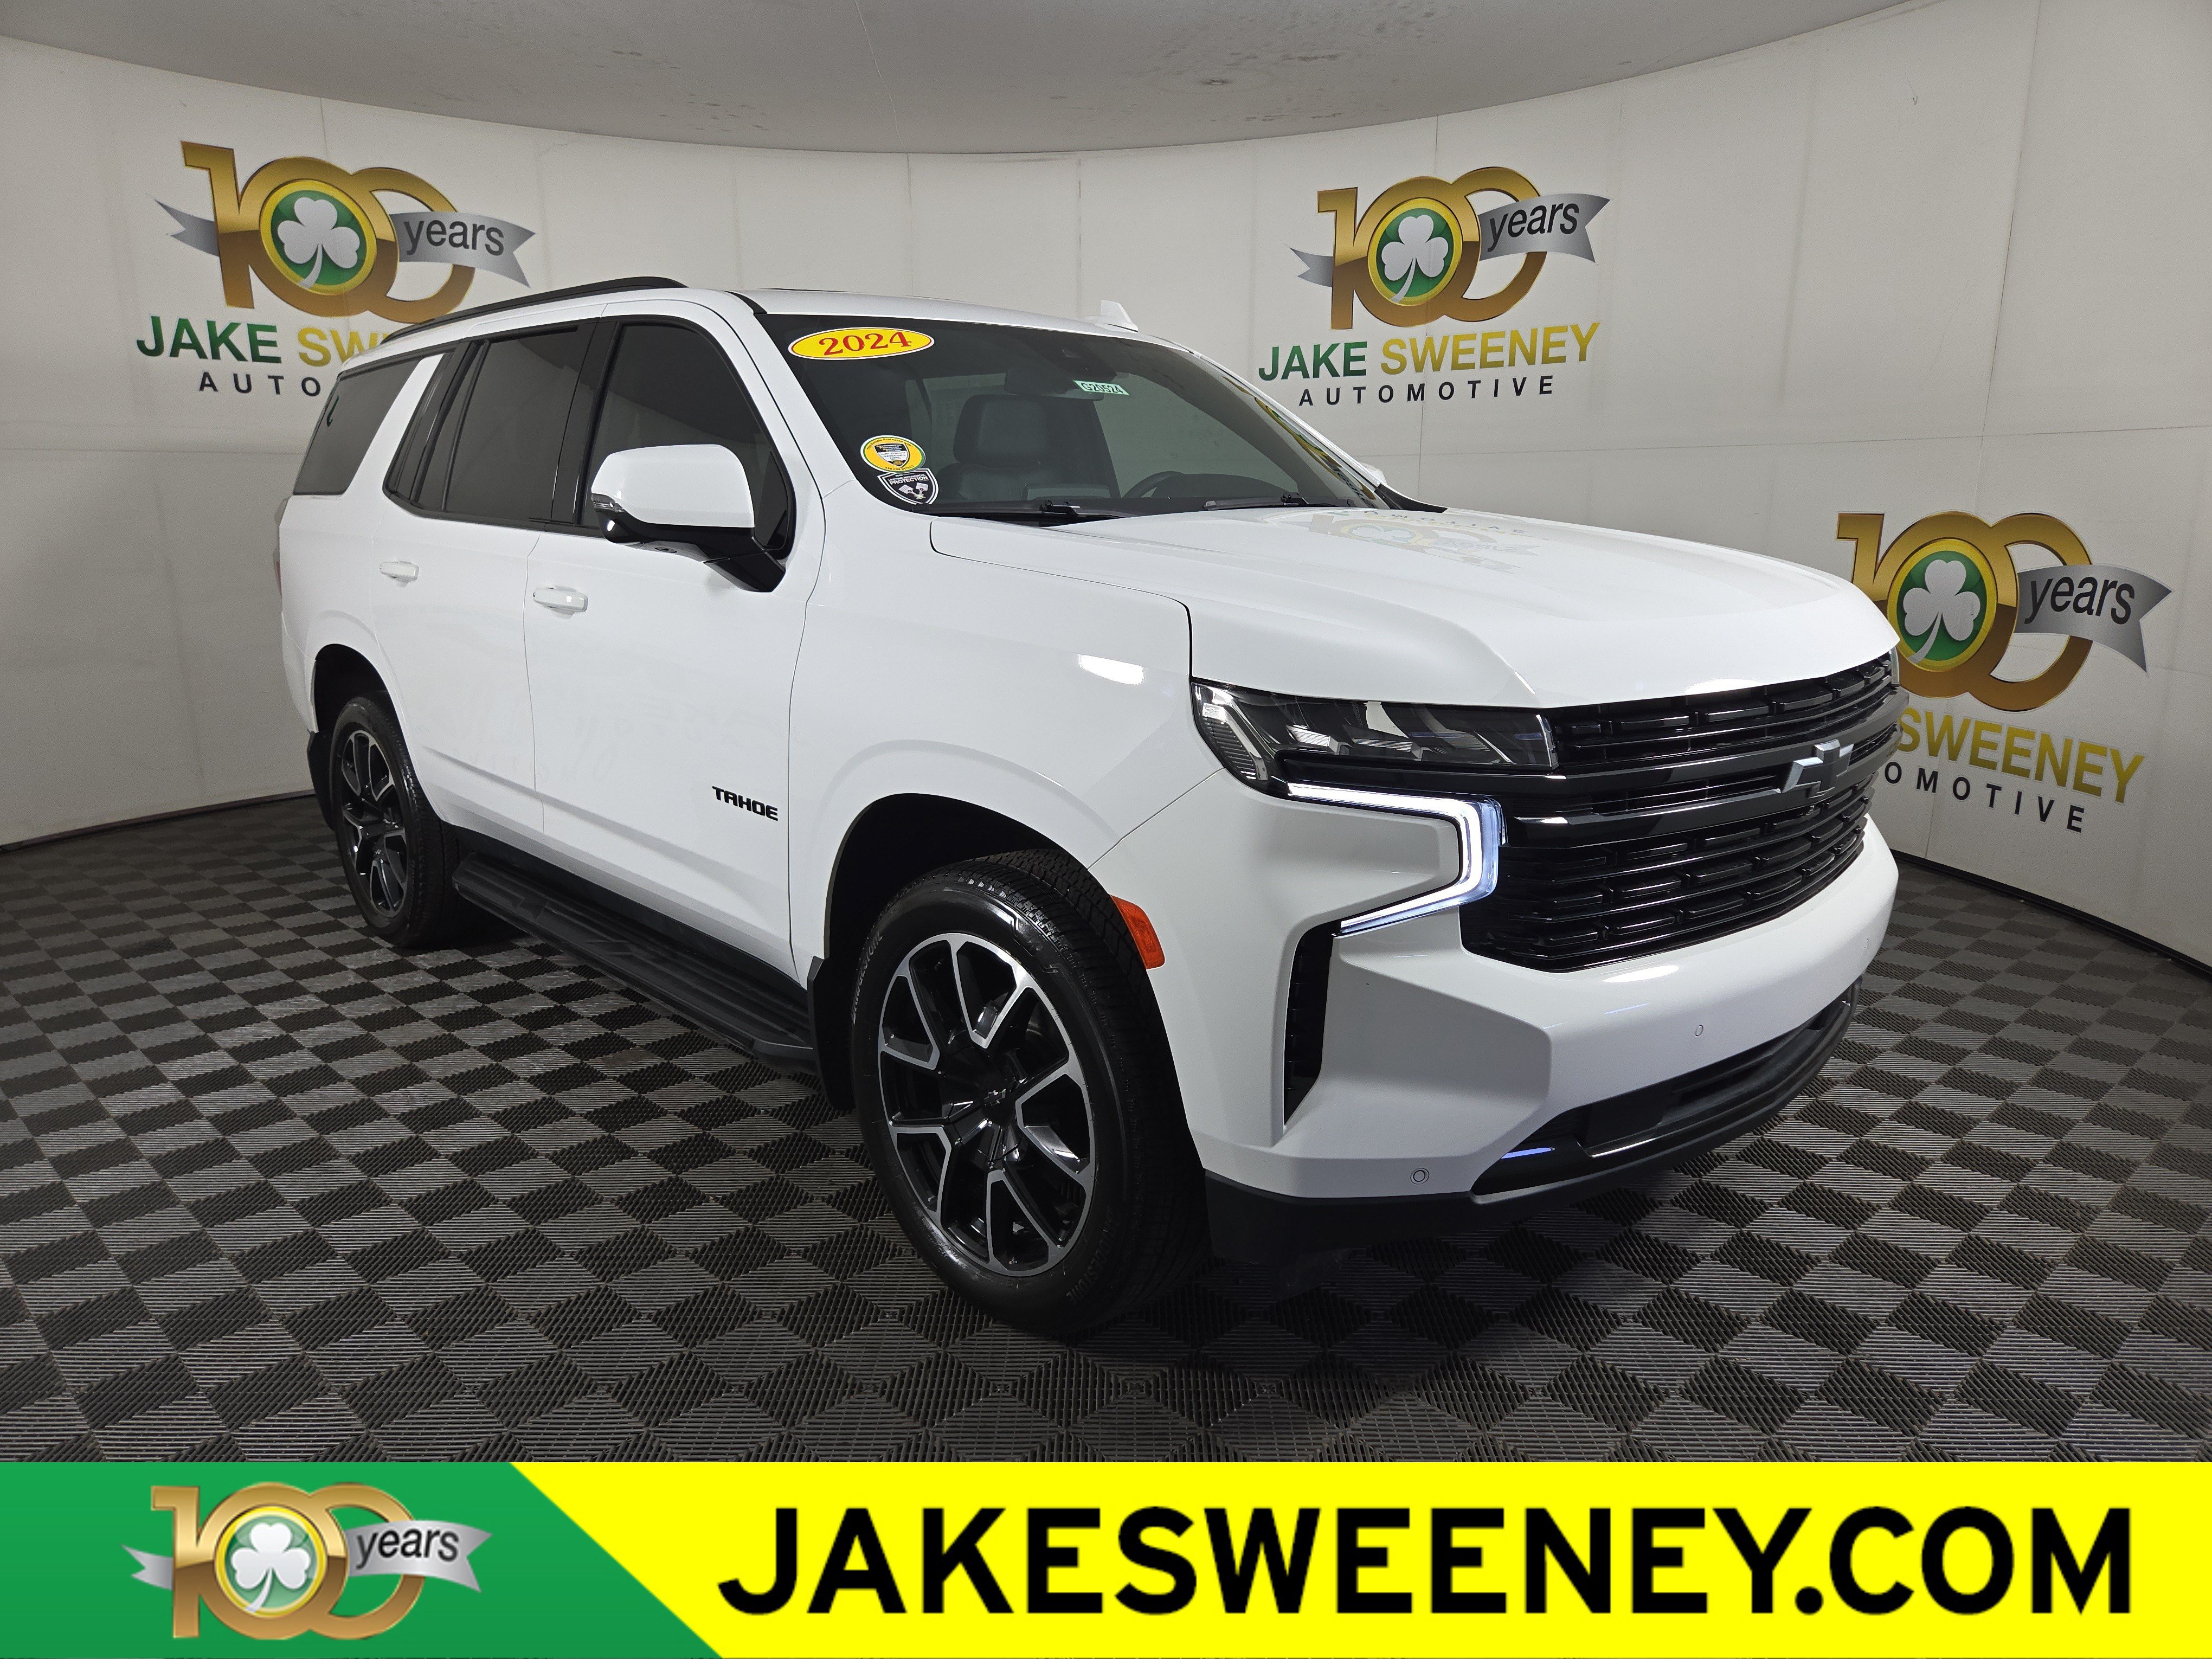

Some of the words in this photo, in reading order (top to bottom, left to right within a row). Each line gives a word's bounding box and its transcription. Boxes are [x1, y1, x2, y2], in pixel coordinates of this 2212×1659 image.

[403, 219, 505, 256] years
[1316, 166, 1547, 330] 100
[1487, 202, 1579, 253] years
[136, 316, 282, 364] JAKE
[819, 332, 912, 356] 2024
[1258, 341, 1368, 382] JAKE
[1380, 321, 1601, 375] SWEENEY
[199, 371, 321, 397] AUTO
[1298, 375, 1554, 407] AUTOMOTIVE
[889, 476, 929, 485] PROTECTION
[2024, 575, 2135, 625] years
[1898, 706, 2145, 804] SWEENEY
[712, 786, 779, 821] TAHOE
[1883, 761, 2085, 833] OMOTIVE
